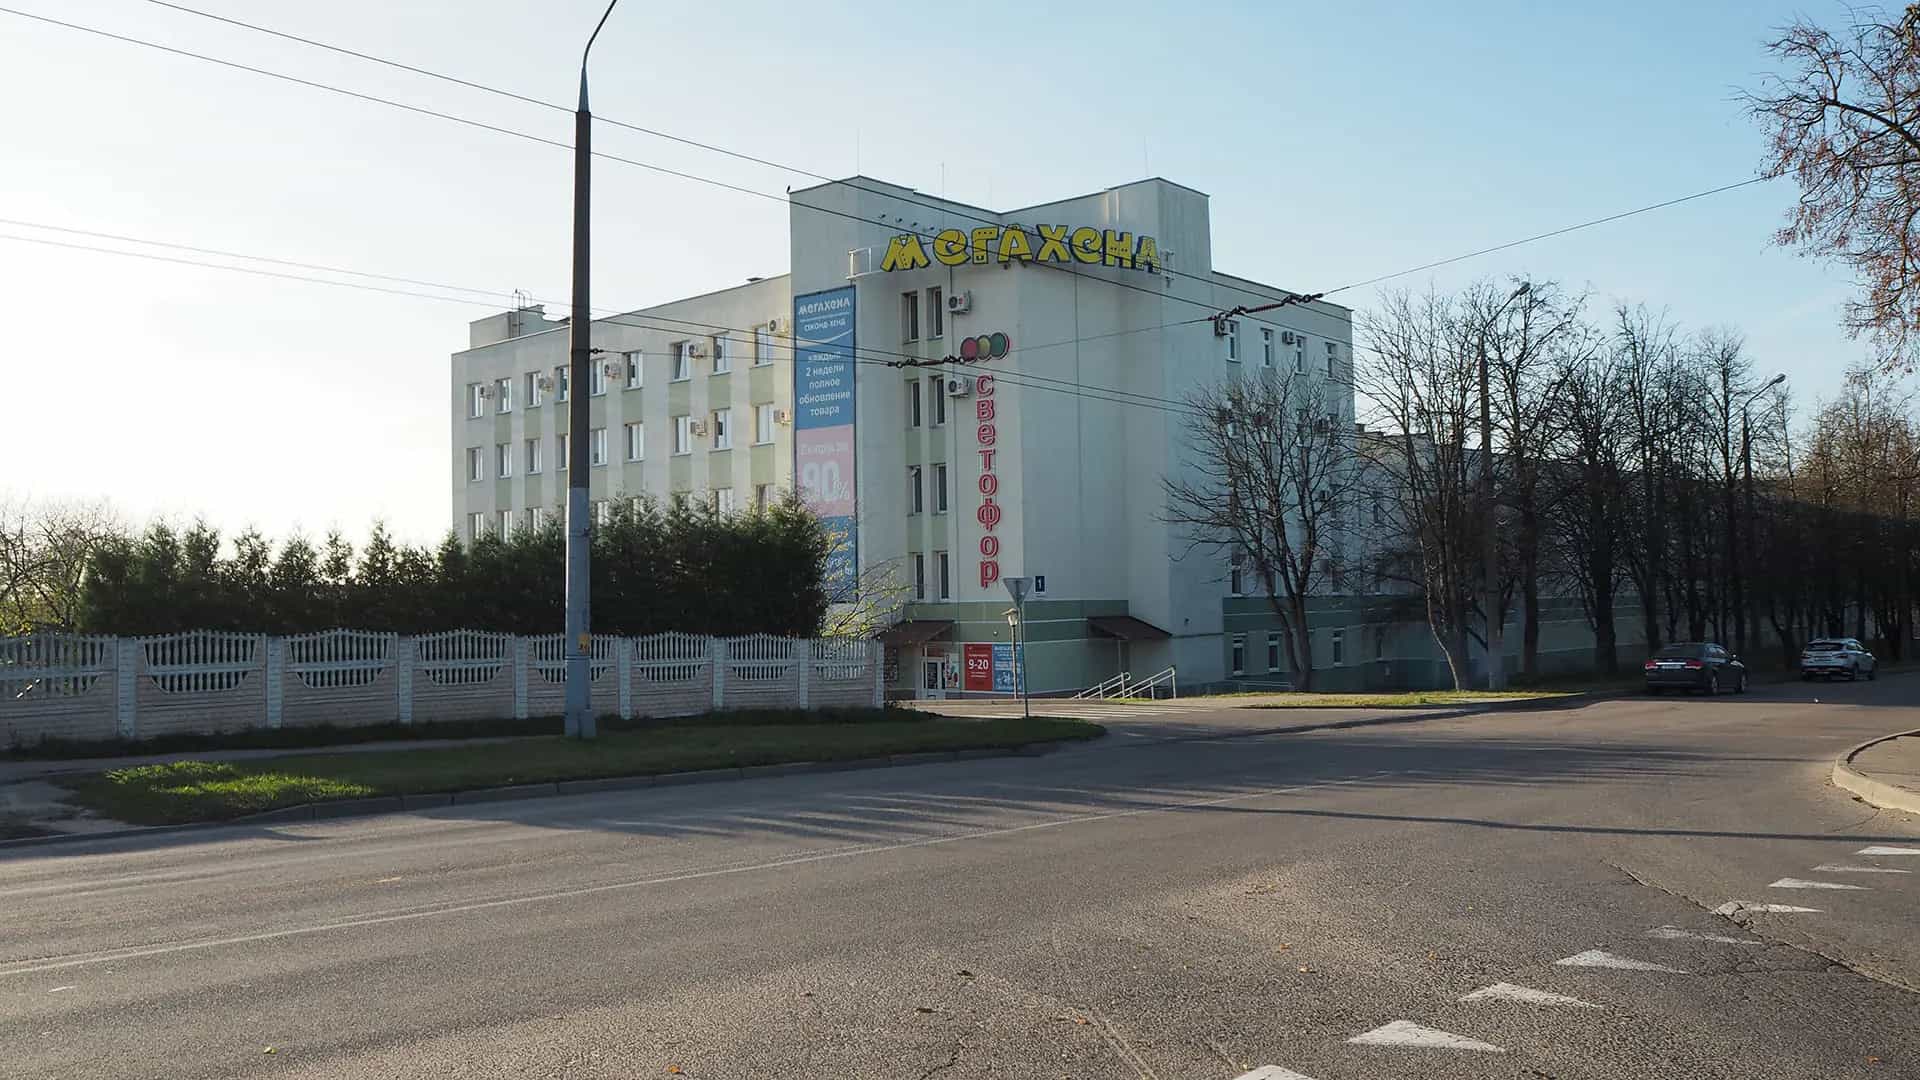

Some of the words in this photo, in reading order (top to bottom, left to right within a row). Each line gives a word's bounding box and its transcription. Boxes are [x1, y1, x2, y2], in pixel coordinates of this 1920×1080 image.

[806, 367, 811, 377] 2
[813, 364, 845, 377] недели
[809, 378, 841, 390] полное
[799, 391, 851, 405] обновление
[810, 405, 840, 417] товара
[968, 659, 989, 670] 9-20
